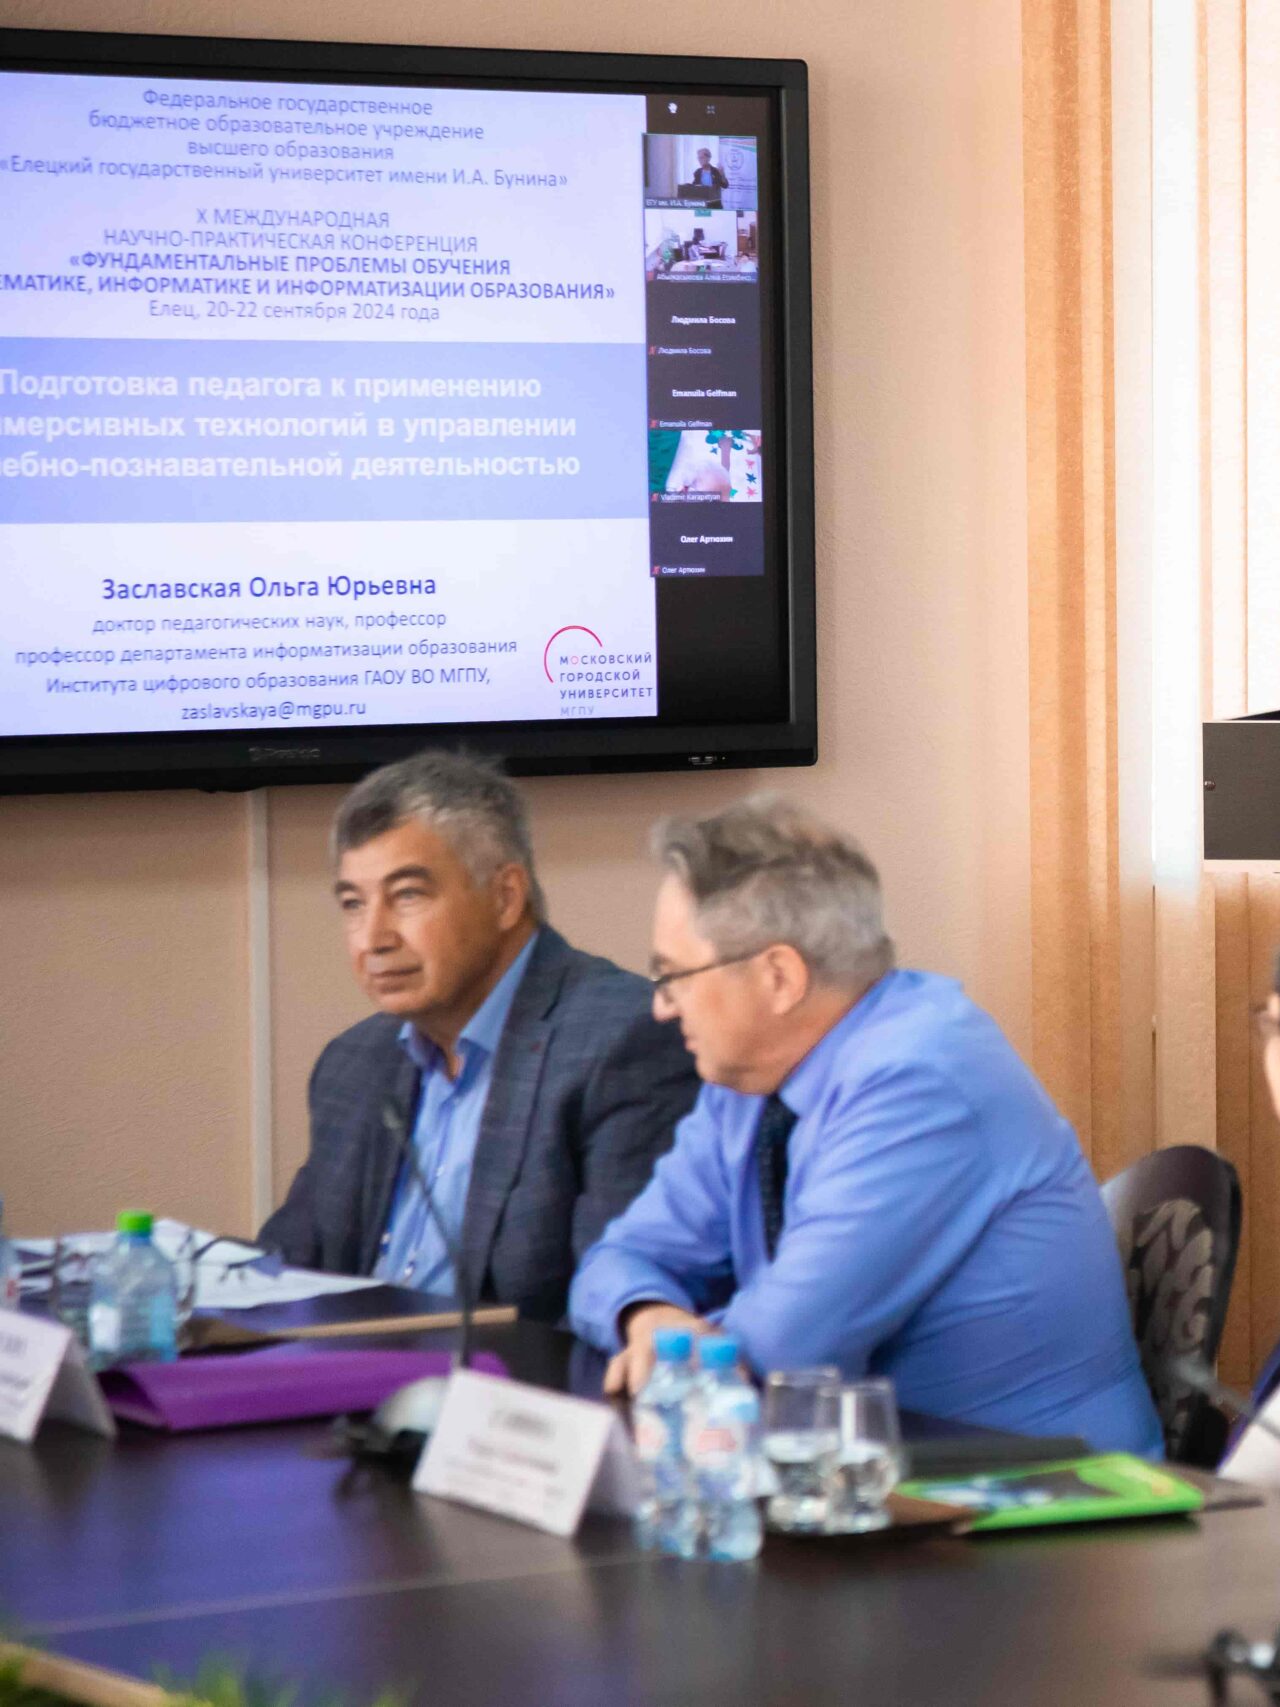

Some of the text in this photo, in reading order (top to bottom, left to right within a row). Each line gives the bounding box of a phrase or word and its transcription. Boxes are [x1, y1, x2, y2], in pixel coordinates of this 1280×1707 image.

[143, 89, 433, 117] Федеральное государственное
[89, 109, 485, 141] бюджетное образовательное учреждение
[187, 140, 395, 161] высшего образования
[99, 162, 265, 181] государственный
[269, 164, 384, 184] университет
[388, 170, 447, 185] имени
[451, 168, 489, 186] И.А.
[494, 169, 569, 190] Бунина»
[213, 208, 390, 229] МЕЖДУНАРОДНАЯ
[103, 229, 479, 254] НАУЧНО-ПРАКТИЧЕСКАЯ КОНФЕРЕНЦИЯ
[70, 252, 511, 276] «ФУНДАМЕНТАЛЬНЫЕ ПРОБЛЕМЫ ОБУЧЕНИЯ
[0, 274, 616, 300] МАТИКЕ, ИНФОРМАТИКЕ И ИНФОРМАТИЗАЦИИ ОБРАЗОВАНИЯ»
[150, 300, 441, 323] Елец, 20-22 сентября 2024 года
[0, 368, 542, 403] Подготовка педагога к применению
[0, 411, 577, 443] мерсивных технологий в управлении
[0, 451, 581, 480] ебно-познавательной деятельностью
[680, 535, 698, 543] Олег
[102, 575, 437, 601] Заславская Ольга Юрьевна
[92, 611, 447, 634] доктор педагогических наук, профессор
[15, 639, 518, 667] профессор департамента информатизации образования
[559, 651, 652, 665] МОСКОВСКИЙ
[46, 667, 492, 695] Института цифрового образования ГАОУ ВО МГПУ,
[559, 669, 640, 682] ГОРОДСКОЙ
[559, 687, 653, 700] УНИВЕРСИТЕТ
[181, 701, 367, 721] zaslavskaya@mgpu.ru
[560, 705, 595, 716] МГПУ
